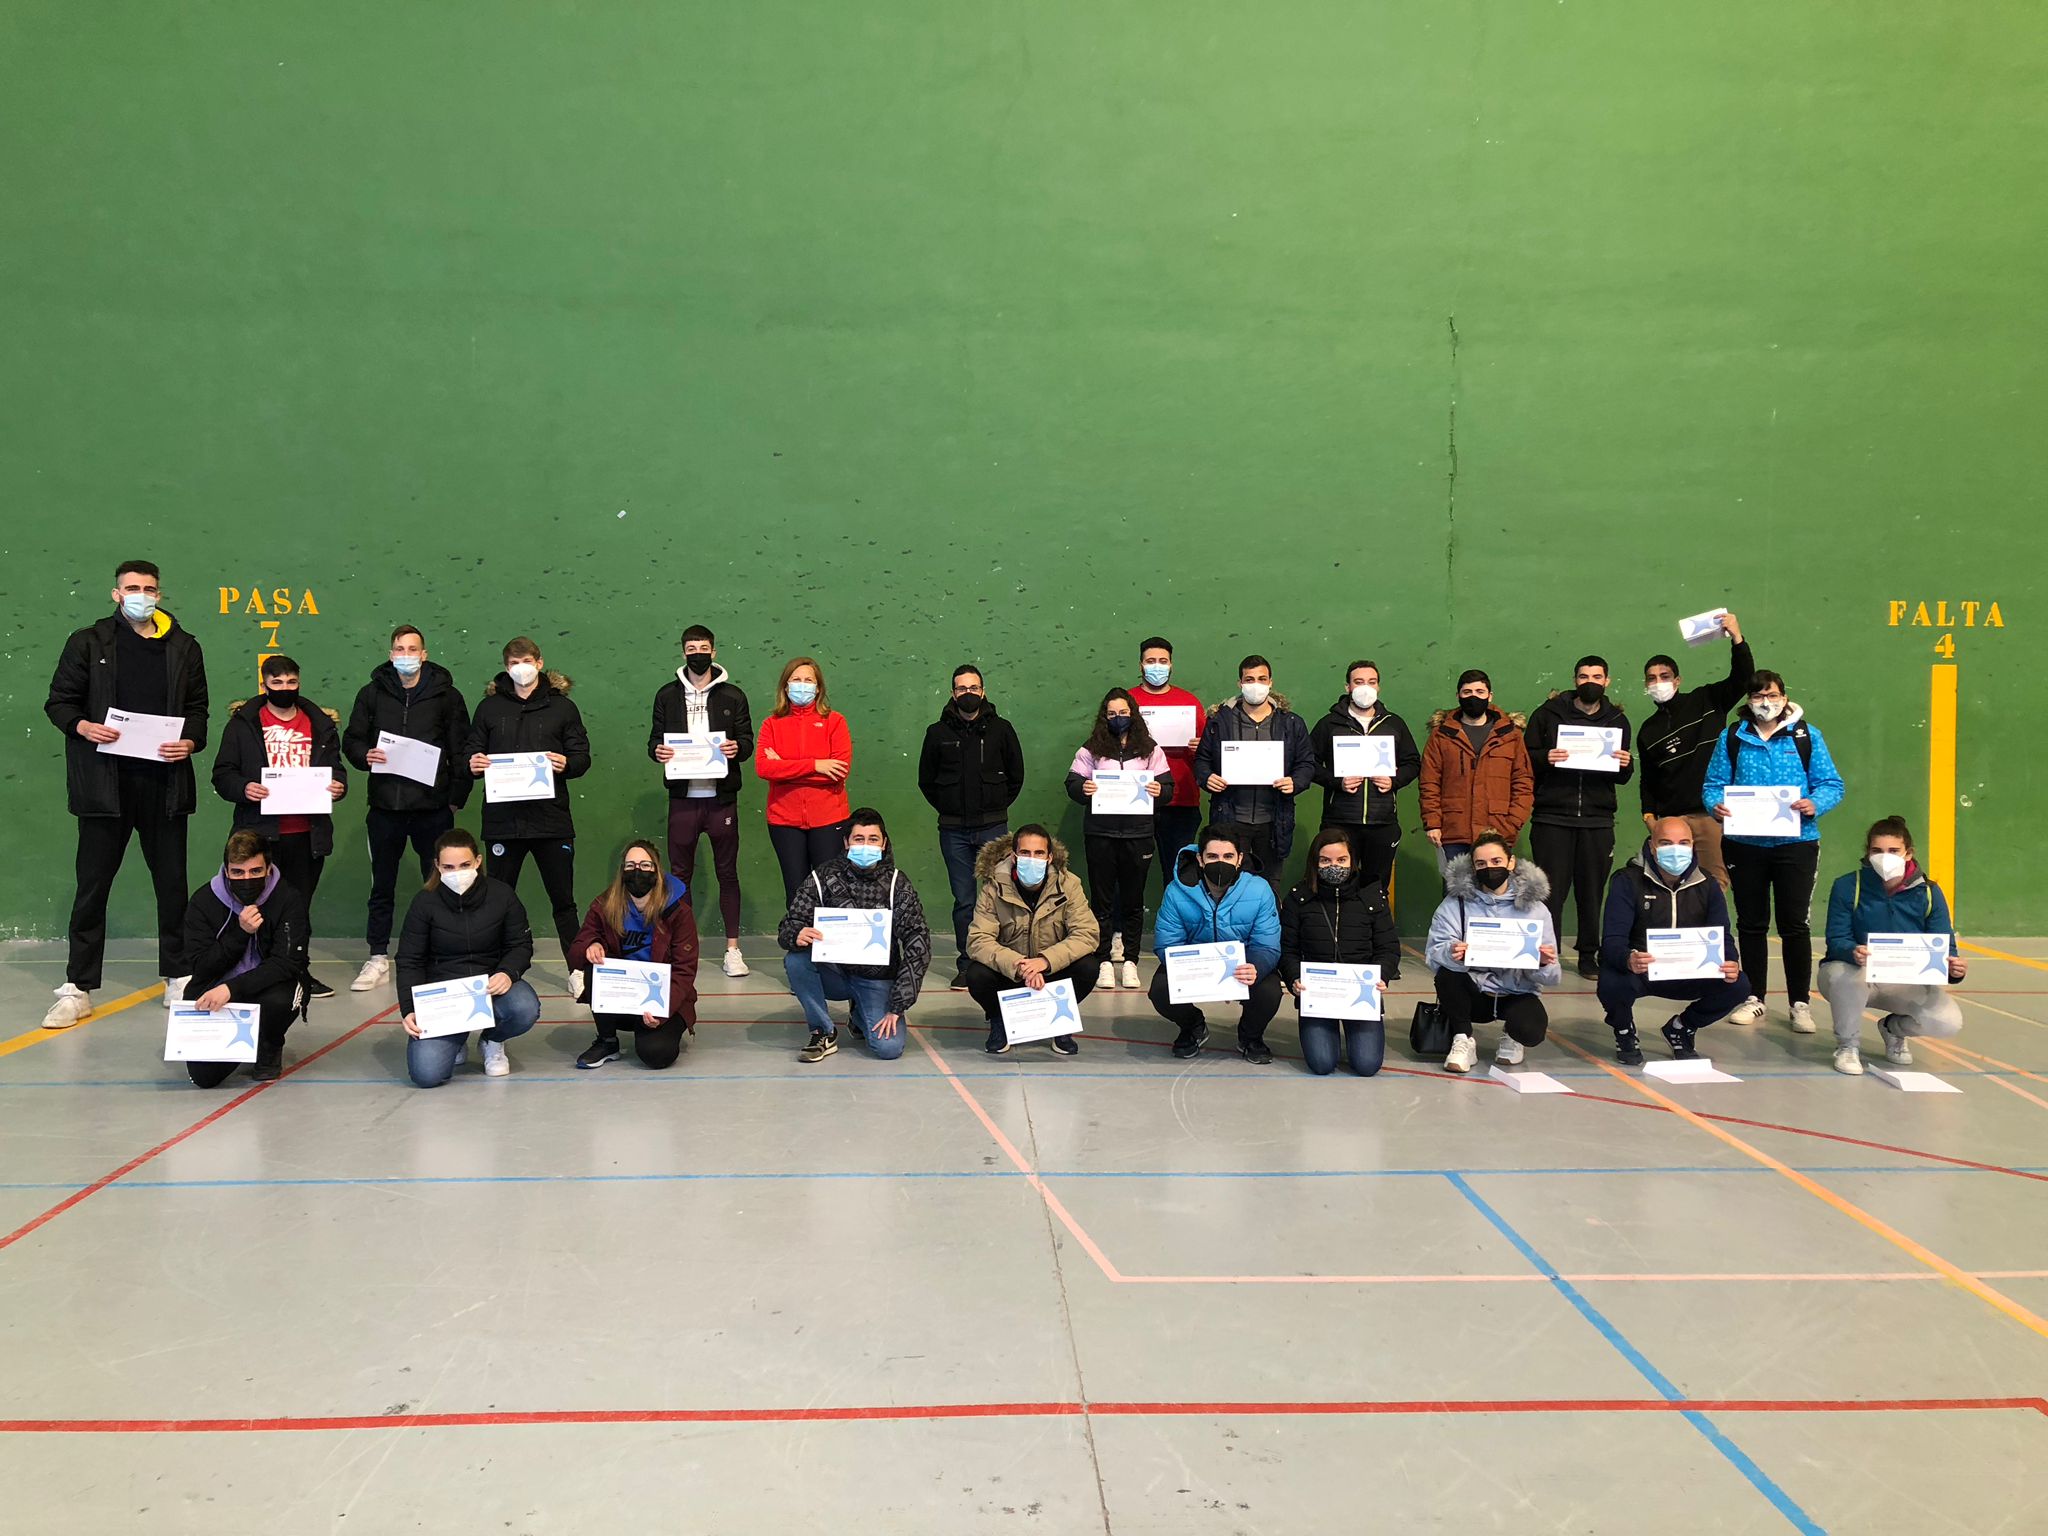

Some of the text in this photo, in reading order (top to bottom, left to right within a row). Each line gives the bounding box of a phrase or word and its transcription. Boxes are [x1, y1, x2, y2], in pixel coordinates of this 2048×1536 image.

[218, 587, 320, 615] PASA
[1887, 600, 2005, 627] FALTA
[260, 621, 280, 648] 7
[1934, 633, 1955, 659] 4
